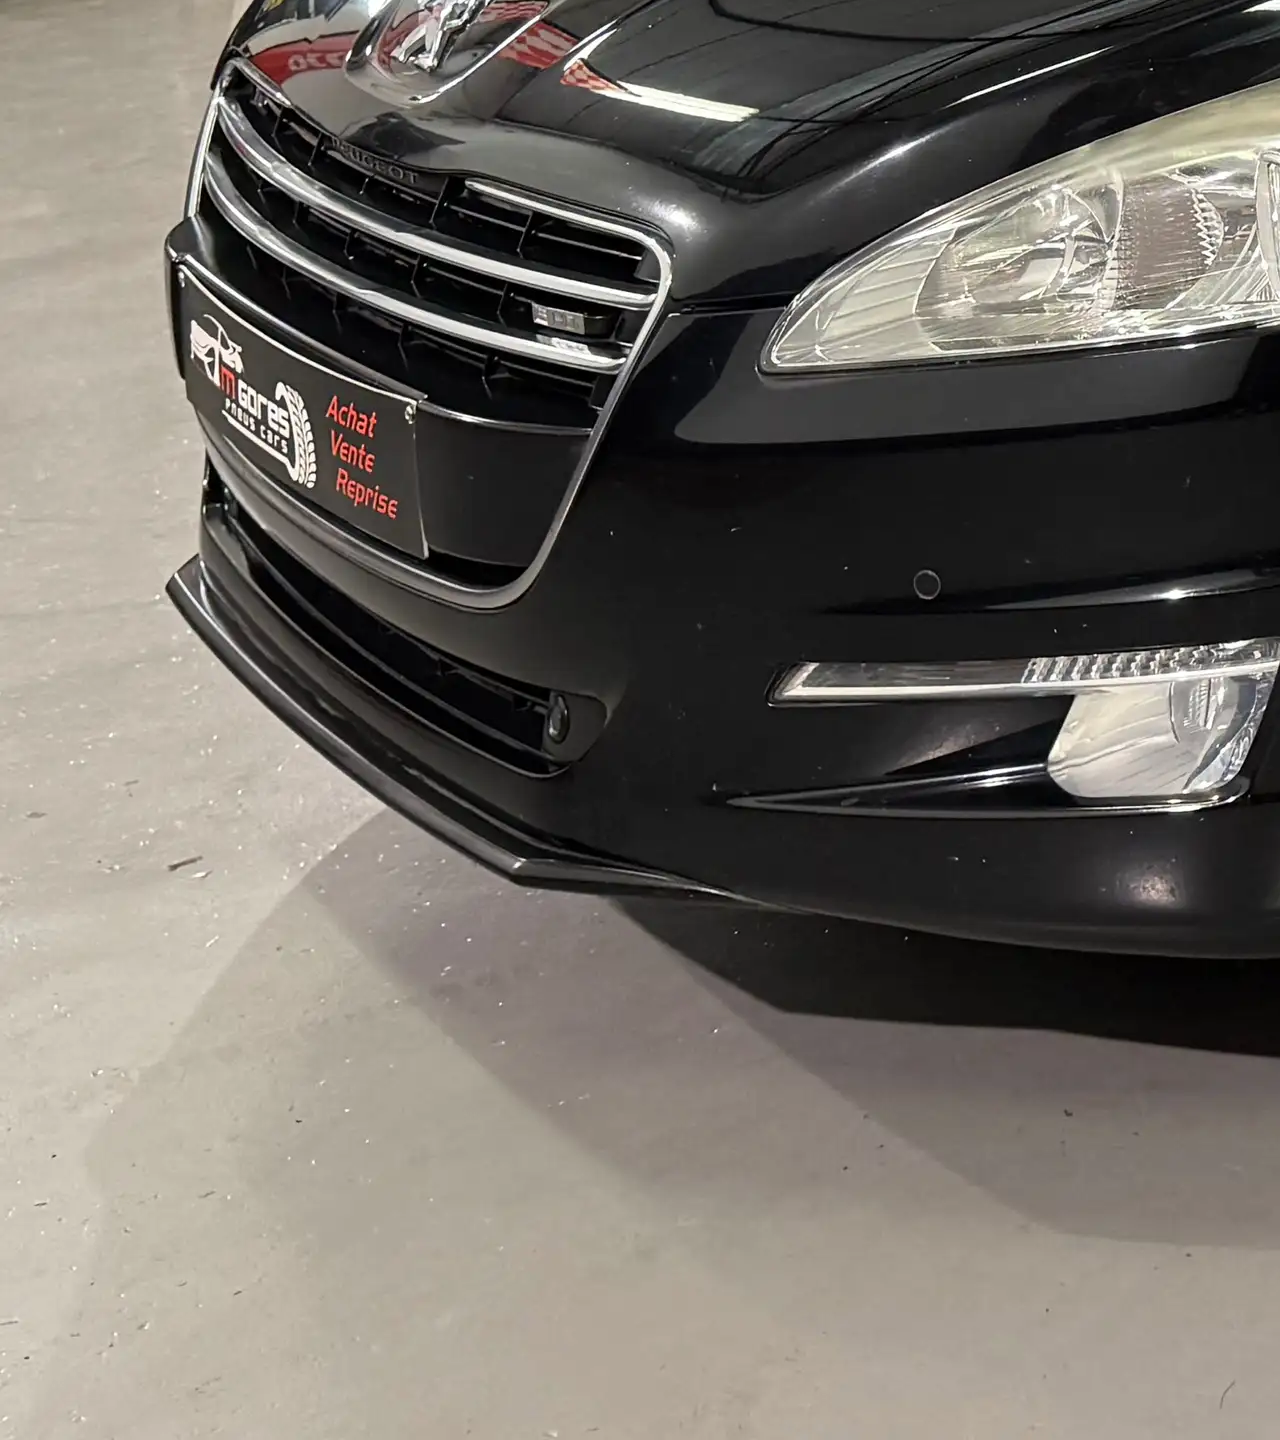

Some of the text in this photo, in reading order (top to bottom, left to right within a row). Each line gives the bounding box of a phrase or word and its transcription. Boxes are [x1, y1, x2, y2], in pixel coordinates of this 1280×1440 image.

[325, 394, 378, 439] Achat
[329, 429, 376, 473] Vente
[335, 467, 399, 521] Reprise
